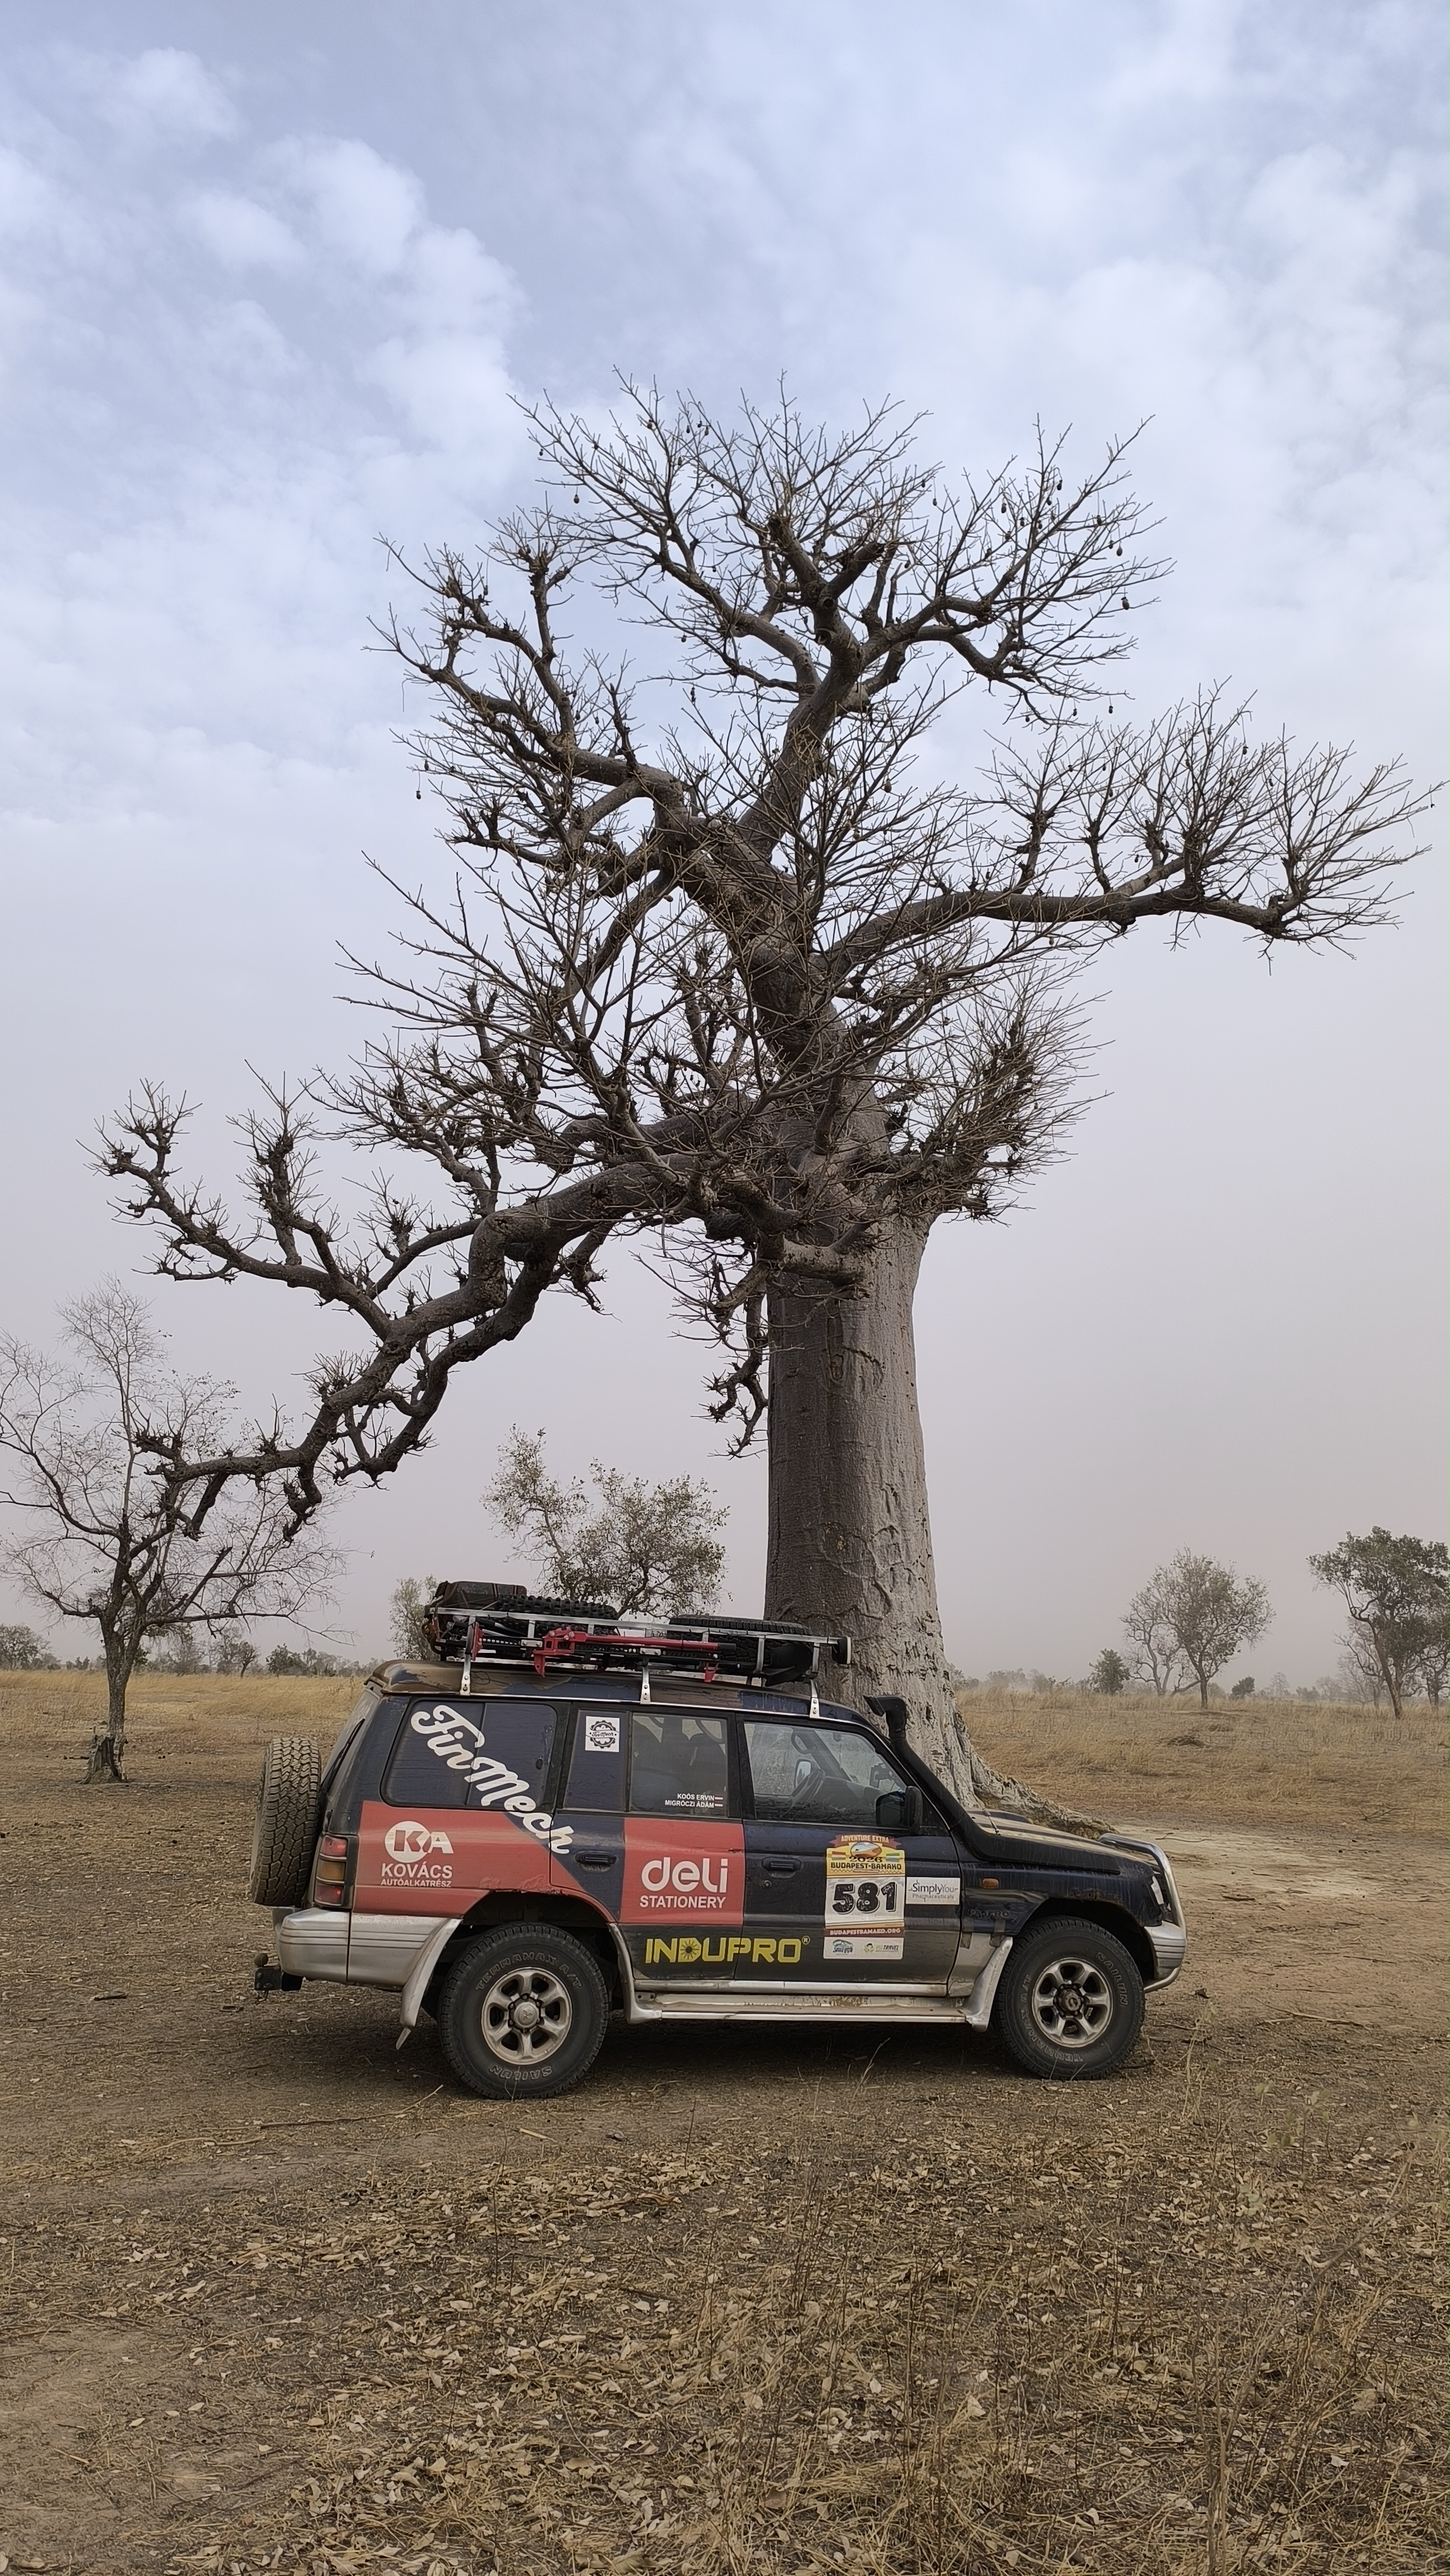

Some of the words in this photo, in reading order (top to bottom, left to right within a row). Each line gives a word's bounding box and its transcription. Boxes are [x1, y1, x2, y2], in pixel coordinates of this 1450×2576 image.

[381, 1861, 453, 1879] KOVÁCS
[381, 1878, 452, 1887] AUTÓALKATRÉSZ
[642, 1857, 728, 1893] deli
[640, 1895, 726, 1909] STATIONERY
[832, 1881, 897, 1915] 581
[476, 1952, 556, 1991] TERRAMAX
[559, 1964, 582, 1988] A/T
[1096, 1952, 1128, 2005] SAILUN
[1021, 2010, 1084, 2062] TERRAMAX
[489, 2063, 553, 2080] SAILUN
